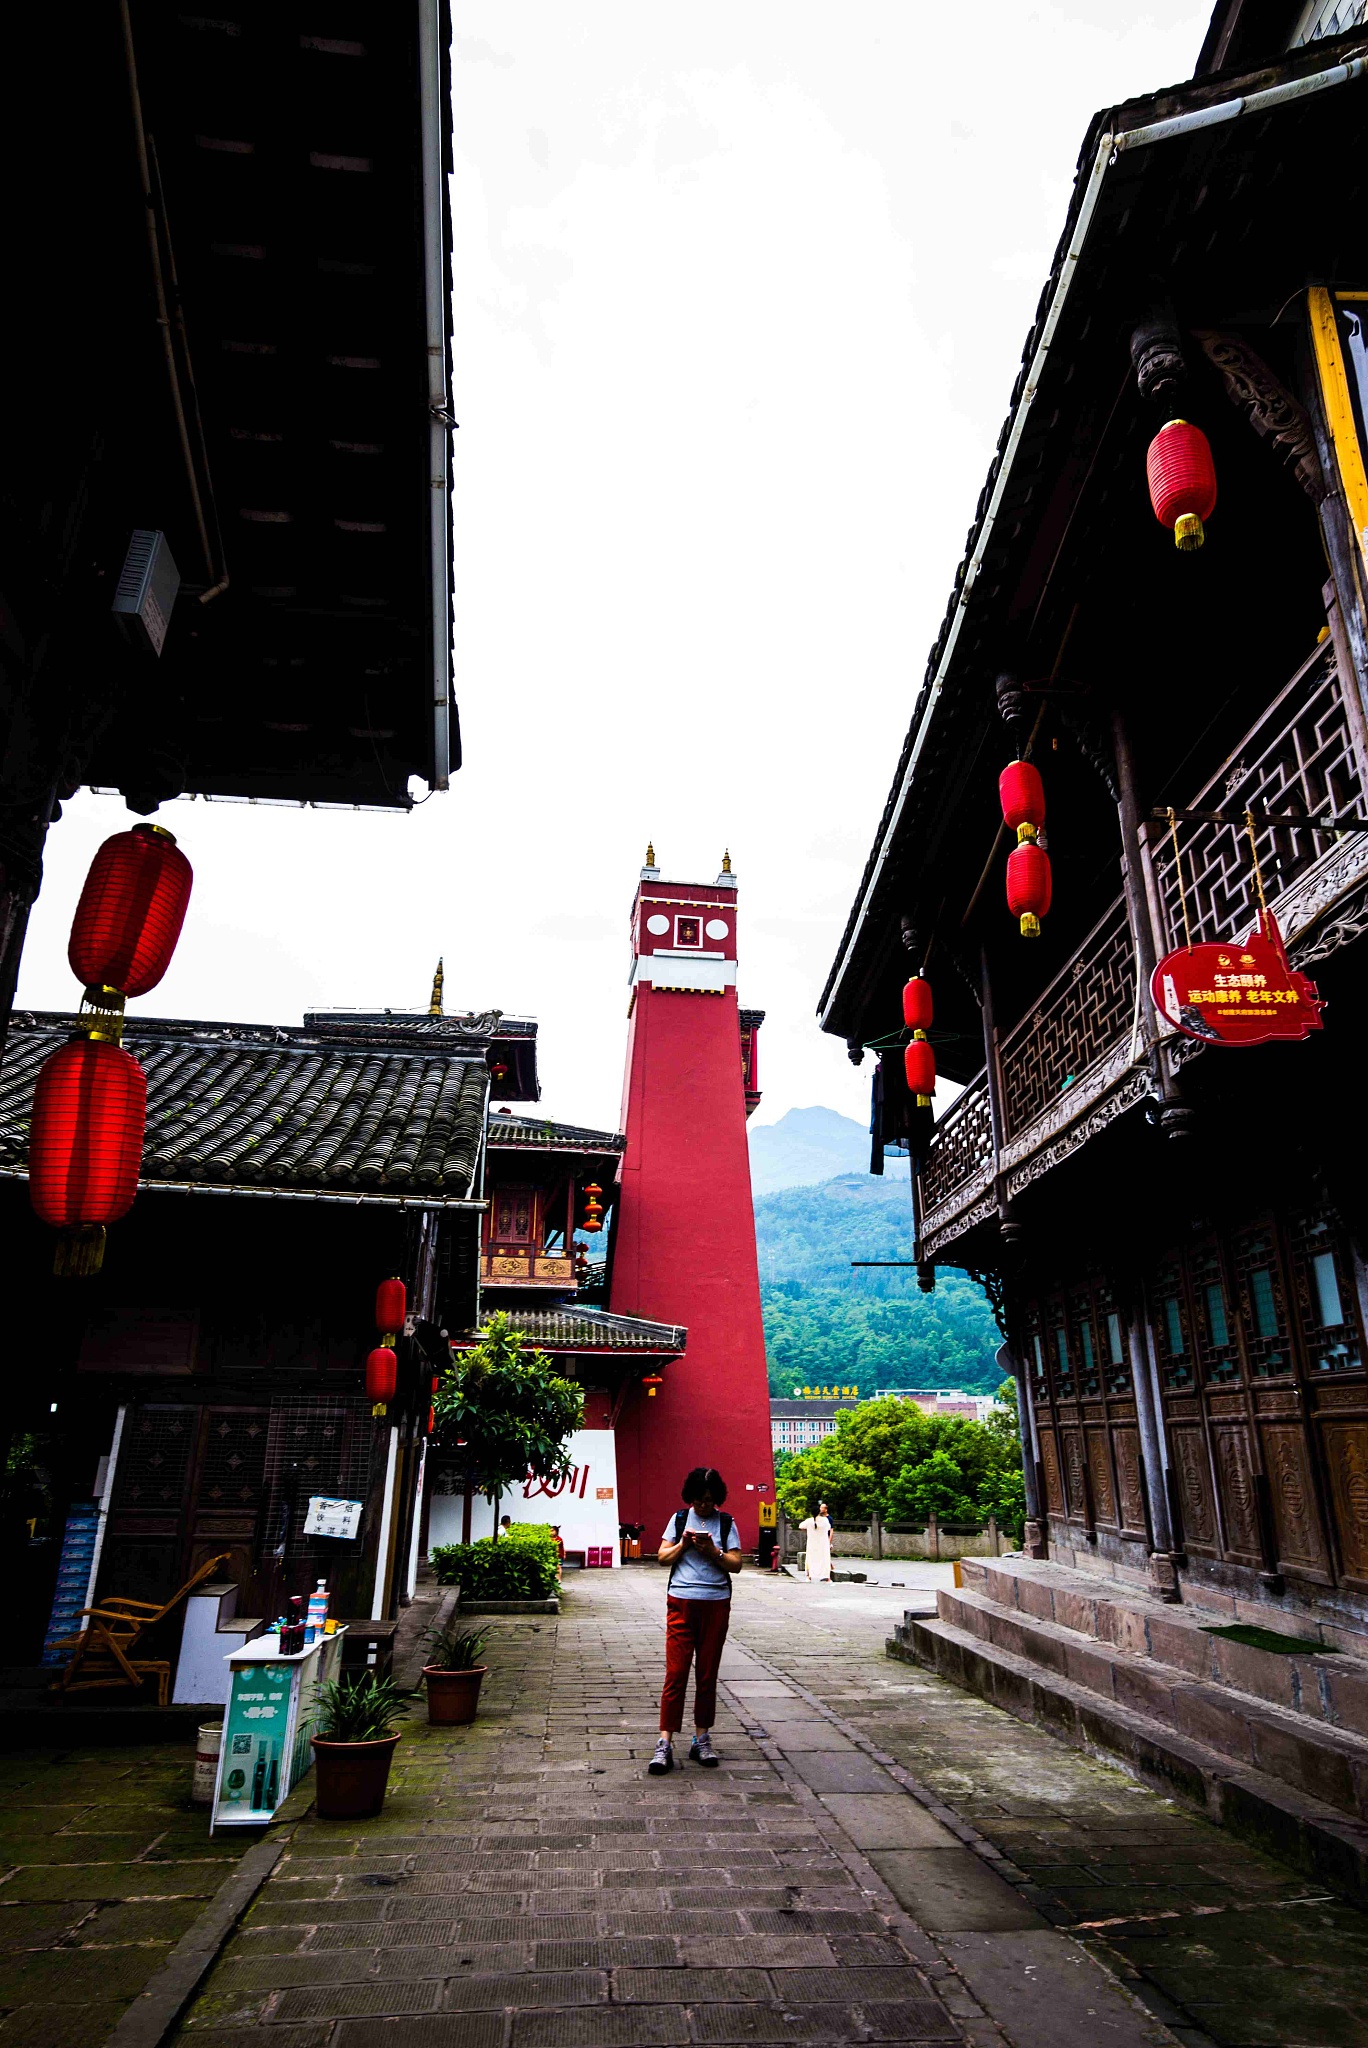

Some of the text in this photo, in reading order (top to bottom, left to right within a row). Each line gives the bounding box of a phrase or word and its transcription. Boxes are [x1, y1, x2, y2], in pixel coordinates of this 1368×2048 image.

[1213, 973, 1268, 988] 生态颐养
[1187, 989, 1242, 1004] 运动康养
[1246, 989, 1300, 1004] 老年文养
[316, 1513, 351, 1525] 饮料
